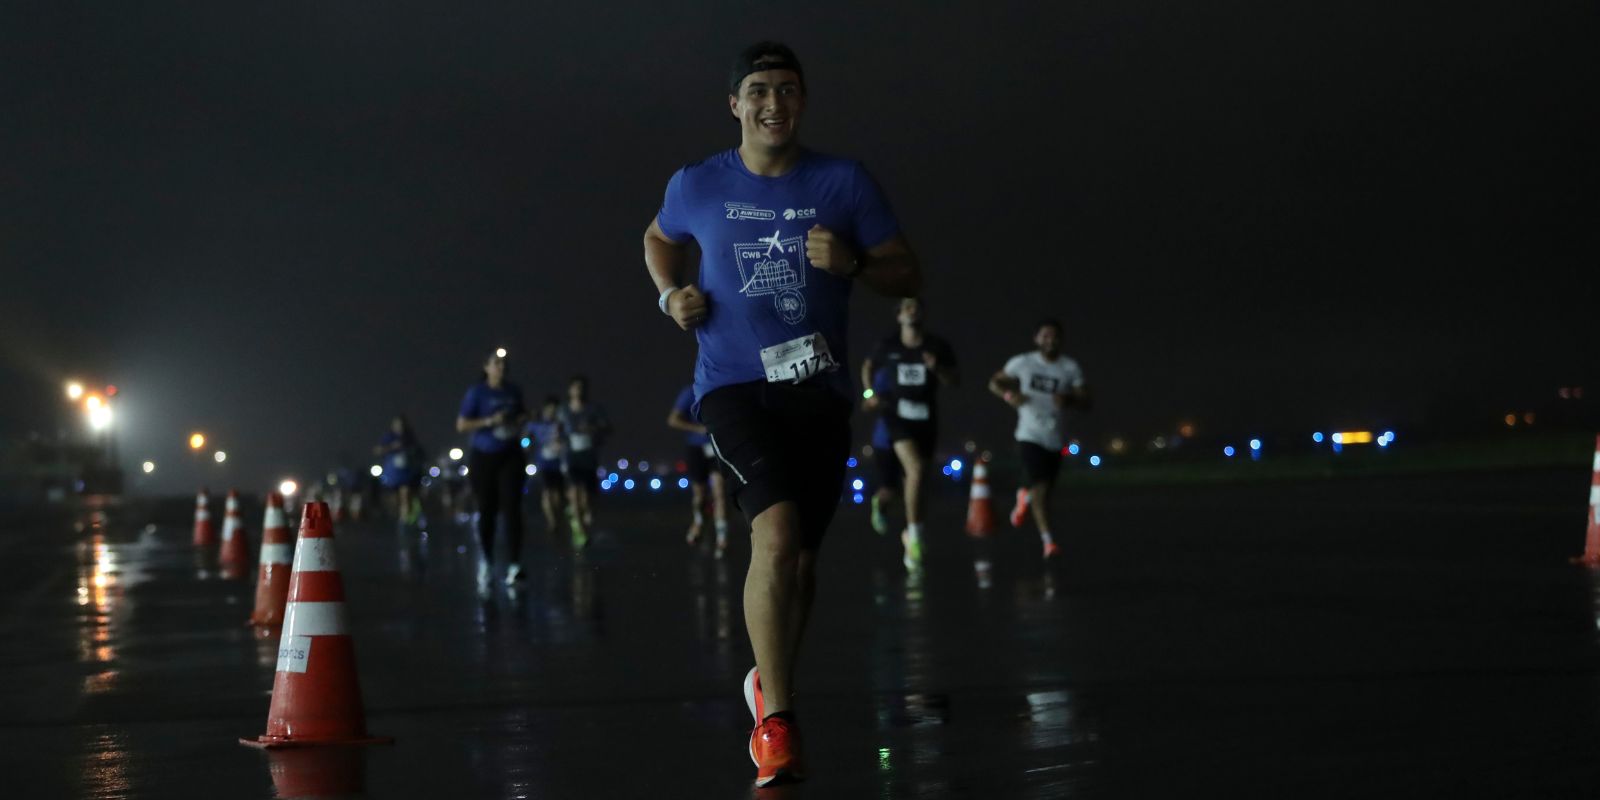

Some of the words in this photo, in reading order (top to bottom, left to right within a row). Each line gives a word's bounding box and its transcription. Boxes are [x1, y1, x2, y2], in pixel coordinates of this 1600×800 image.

[796, 208, 816, 216] CCR
[787, 245, 797, 253] 41
[742, 251, 761, 259] CWB
